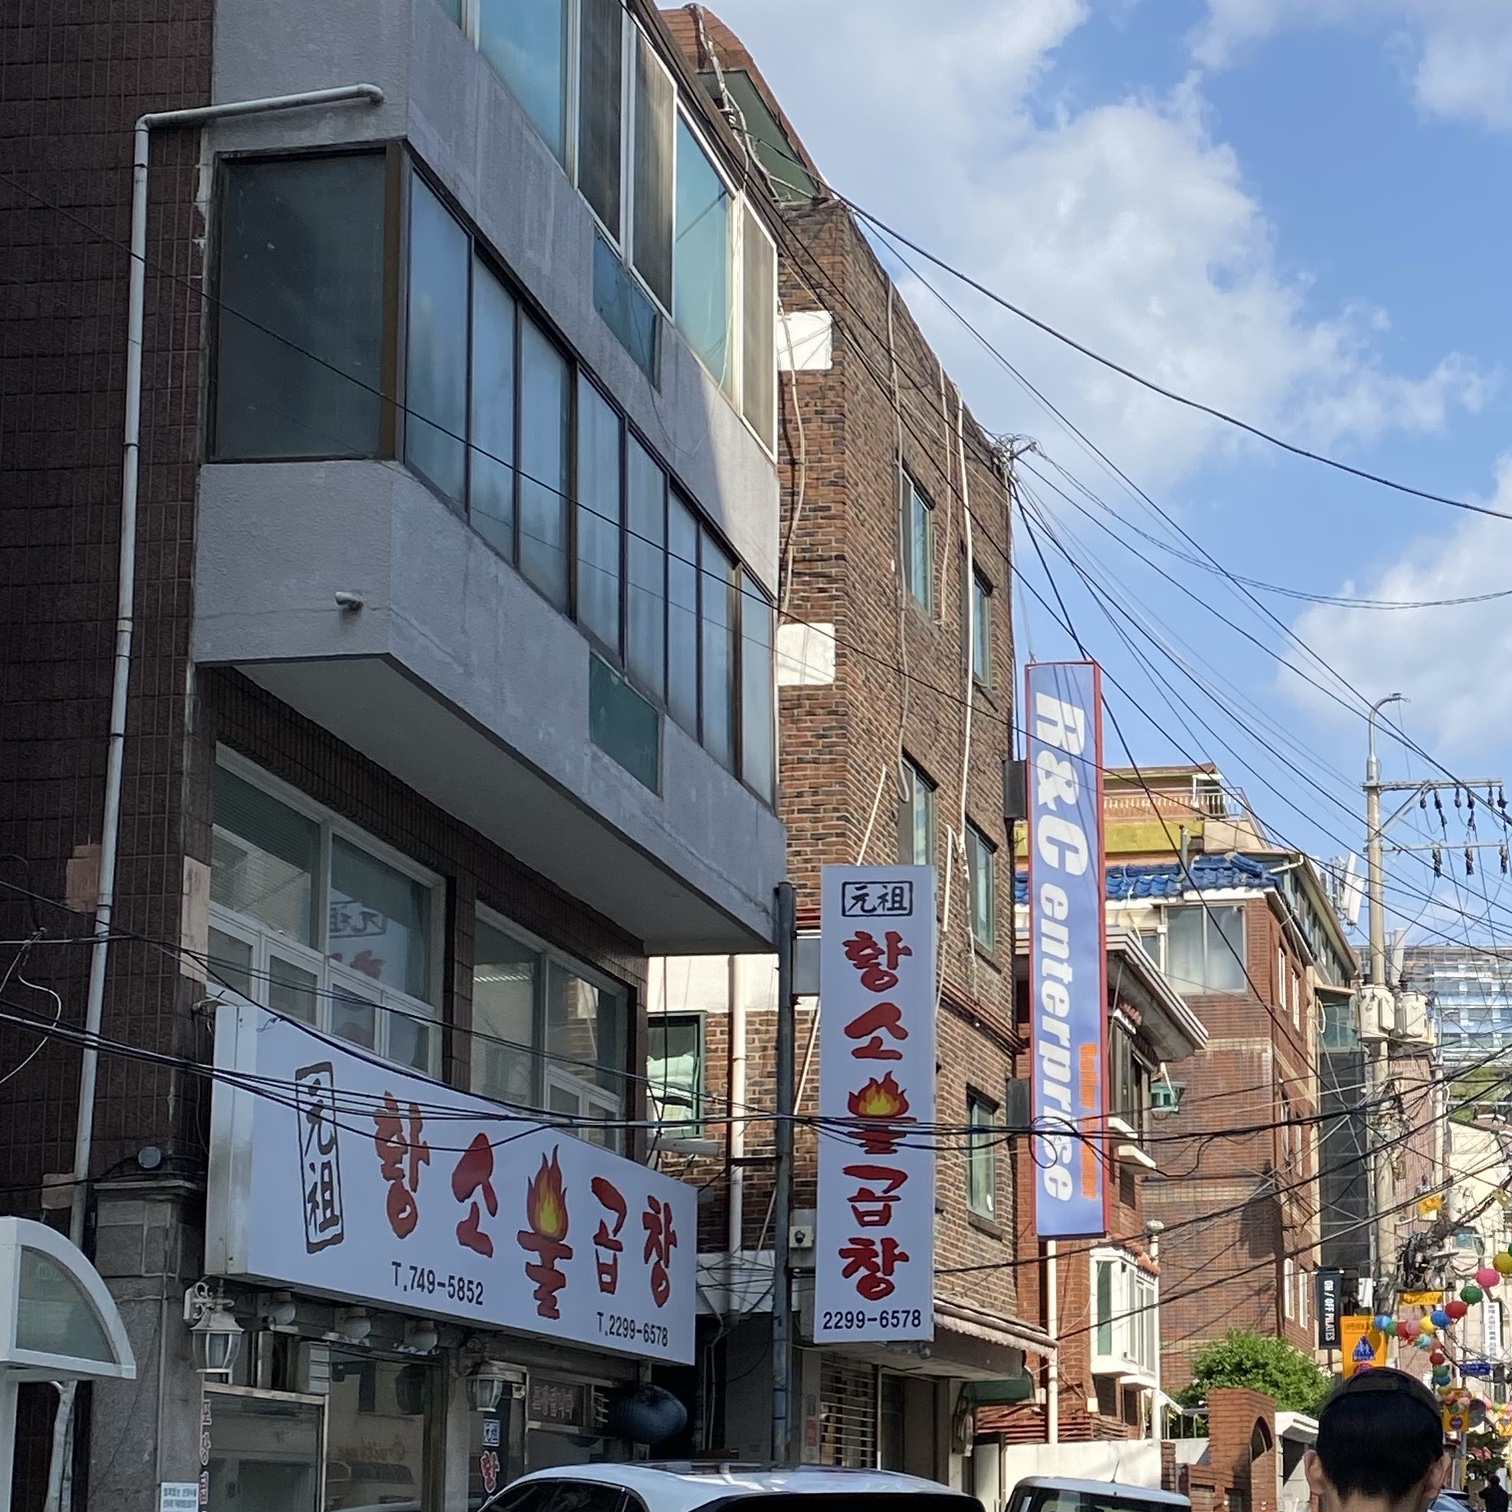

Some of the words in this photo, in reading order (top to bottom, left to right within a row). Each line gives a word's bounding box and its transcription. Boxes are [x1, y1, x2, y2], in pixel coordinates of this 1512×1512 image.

[1034, 692, 1088, 877] R&C
[1034, 893, 1077, 1202] enterprise
[391, 1261, 484, 1307] T.749-5852
[597, 1311, 669, 1348] T.2299-6578
[822, 1308, 922, 1331] 2299-6578
